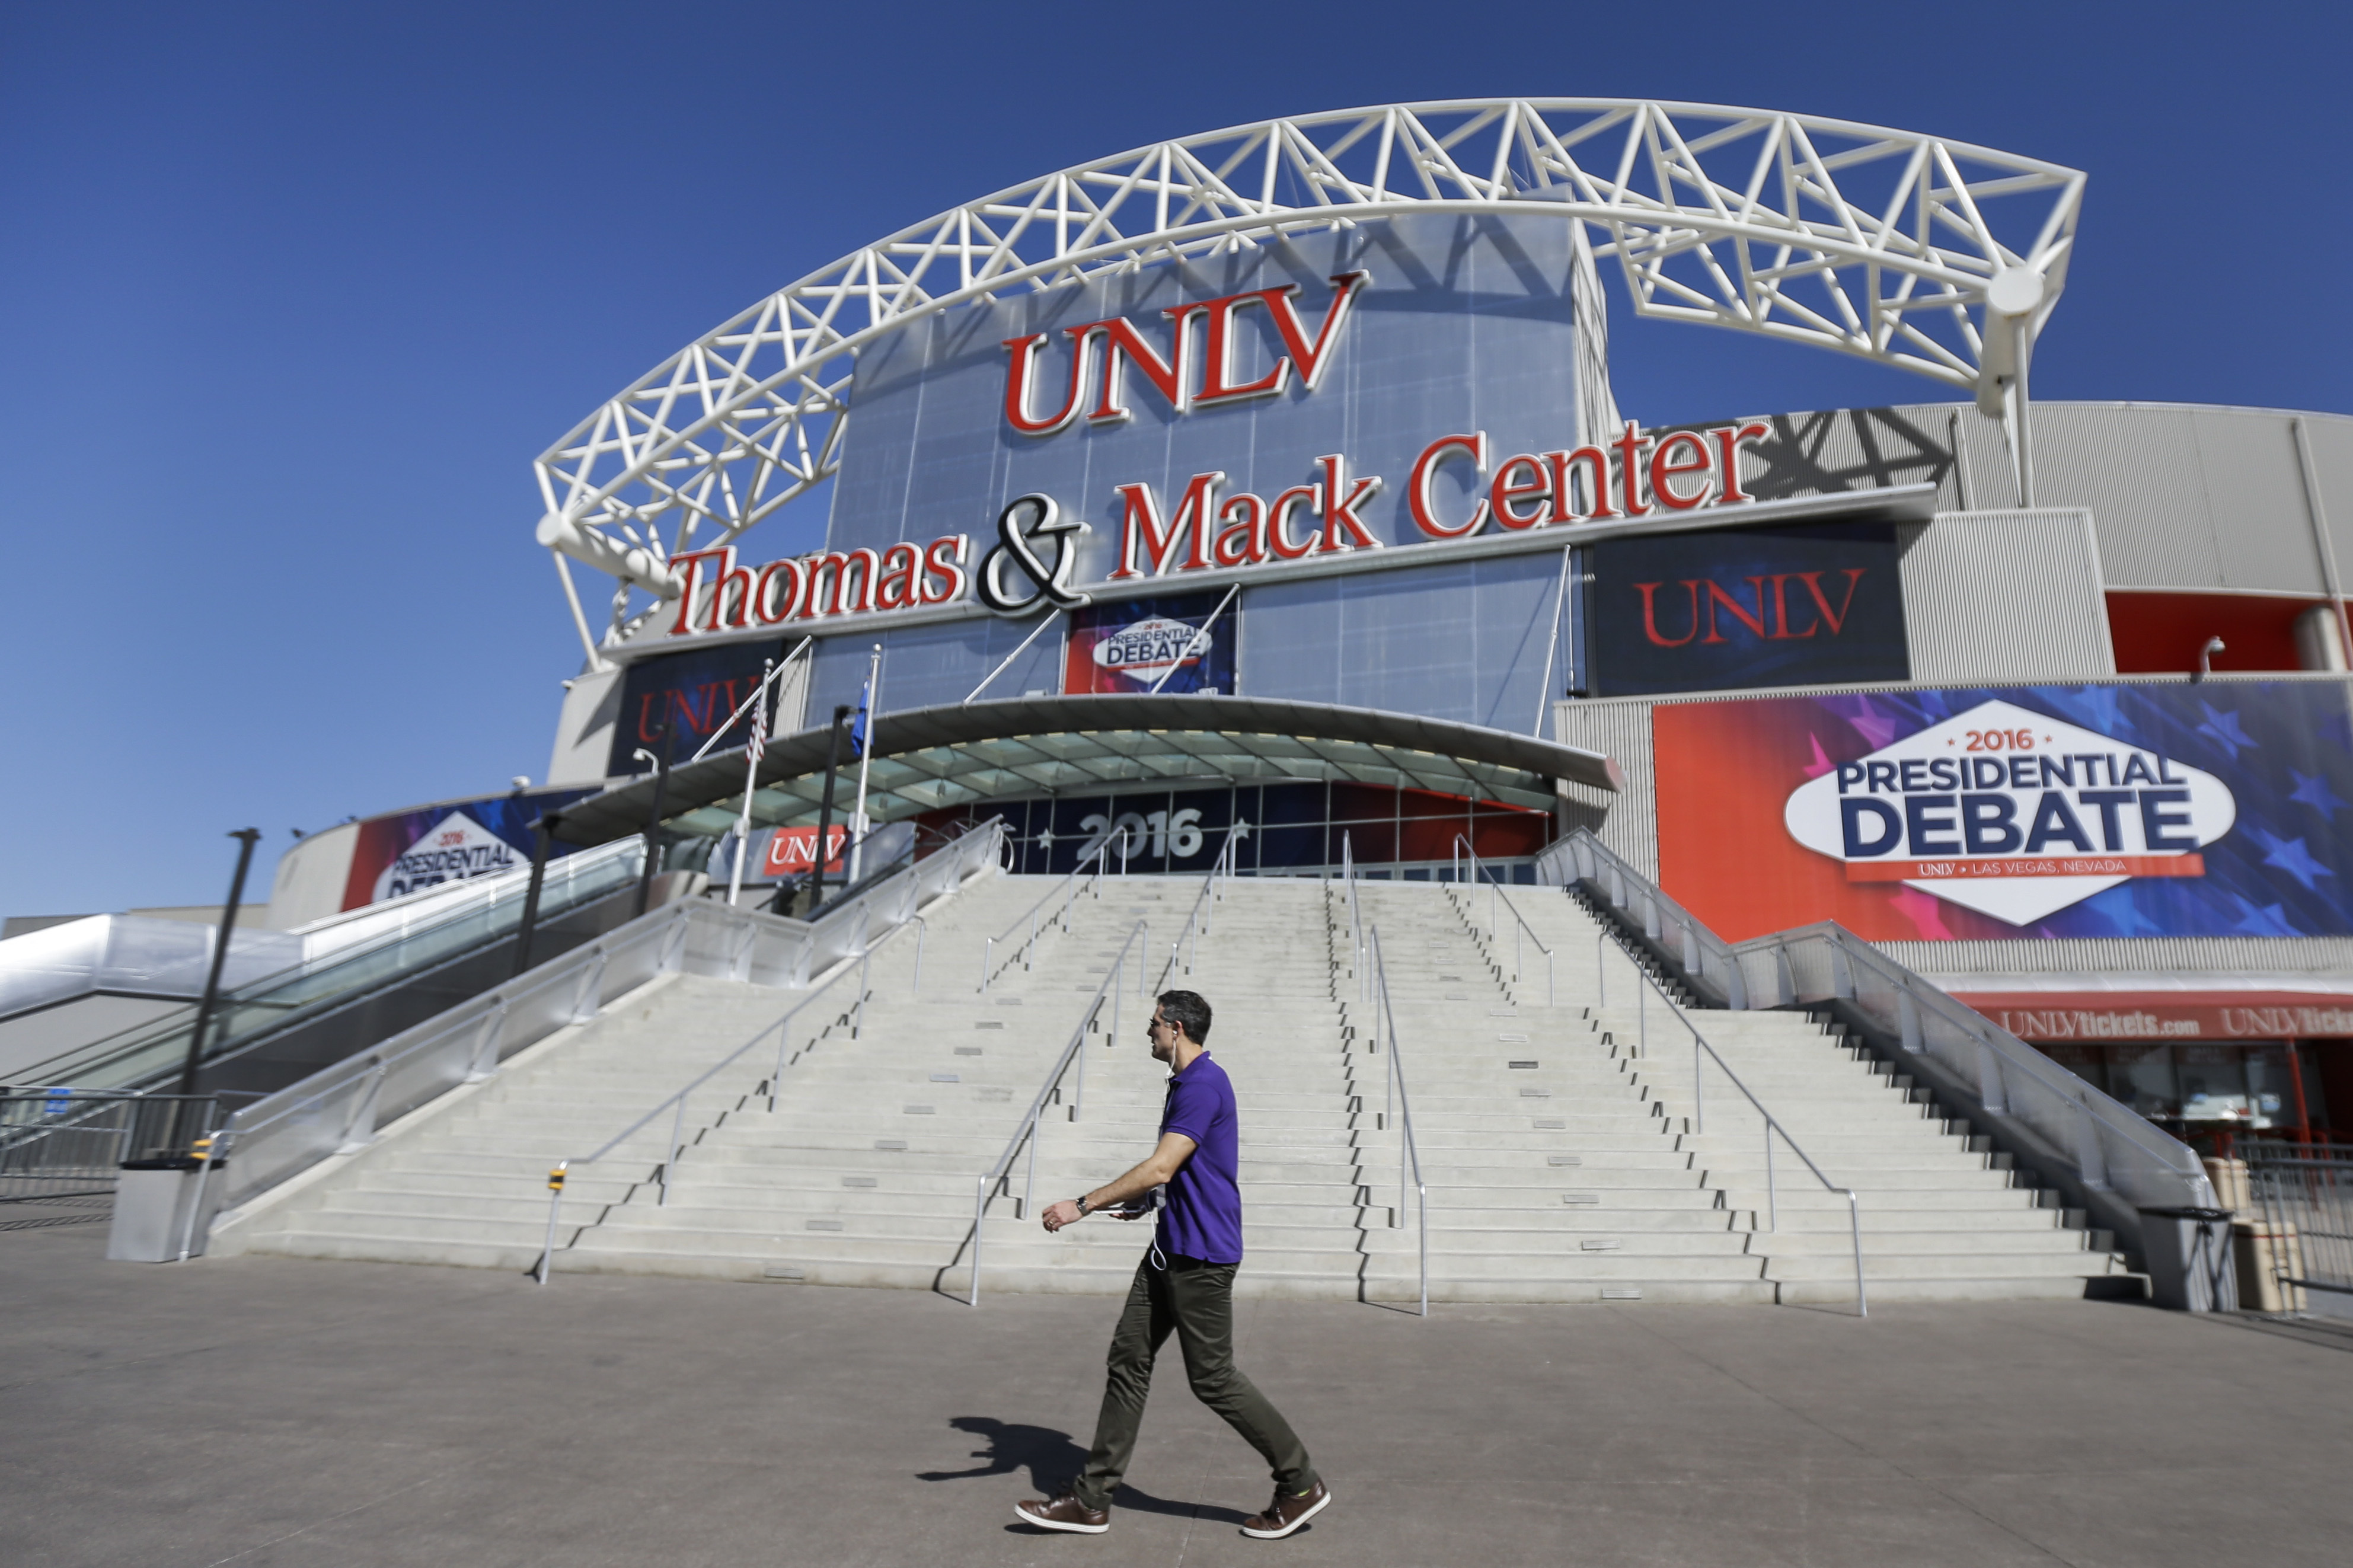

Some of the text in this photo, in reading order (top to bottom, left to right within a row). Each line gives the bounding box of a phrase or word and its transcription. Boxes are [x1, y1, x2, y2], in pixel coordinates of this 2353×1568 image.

[1002, 269, 1370, 436] UNLV
[667, 419, 1774, 637] Thomas & Mack Center
[1633, 568, 1868, 648] UNLV
[1107, 640, 1201, 665] DEBATE
[638, 675, 760, 743] UNLV
[1966, 729, 2035, 751] 2016
[1837, 753, 2187, 794] PRESIDENTIAL
[1077, 807, 1203, 860] 2016
[1840, 789, 2200, 857] DEBATE
[1919, 860, 2127, 876] UNLV LAS VEGAS, NEVADA
[2001, 1011, 2201, 1037] UNLVtickets.com
